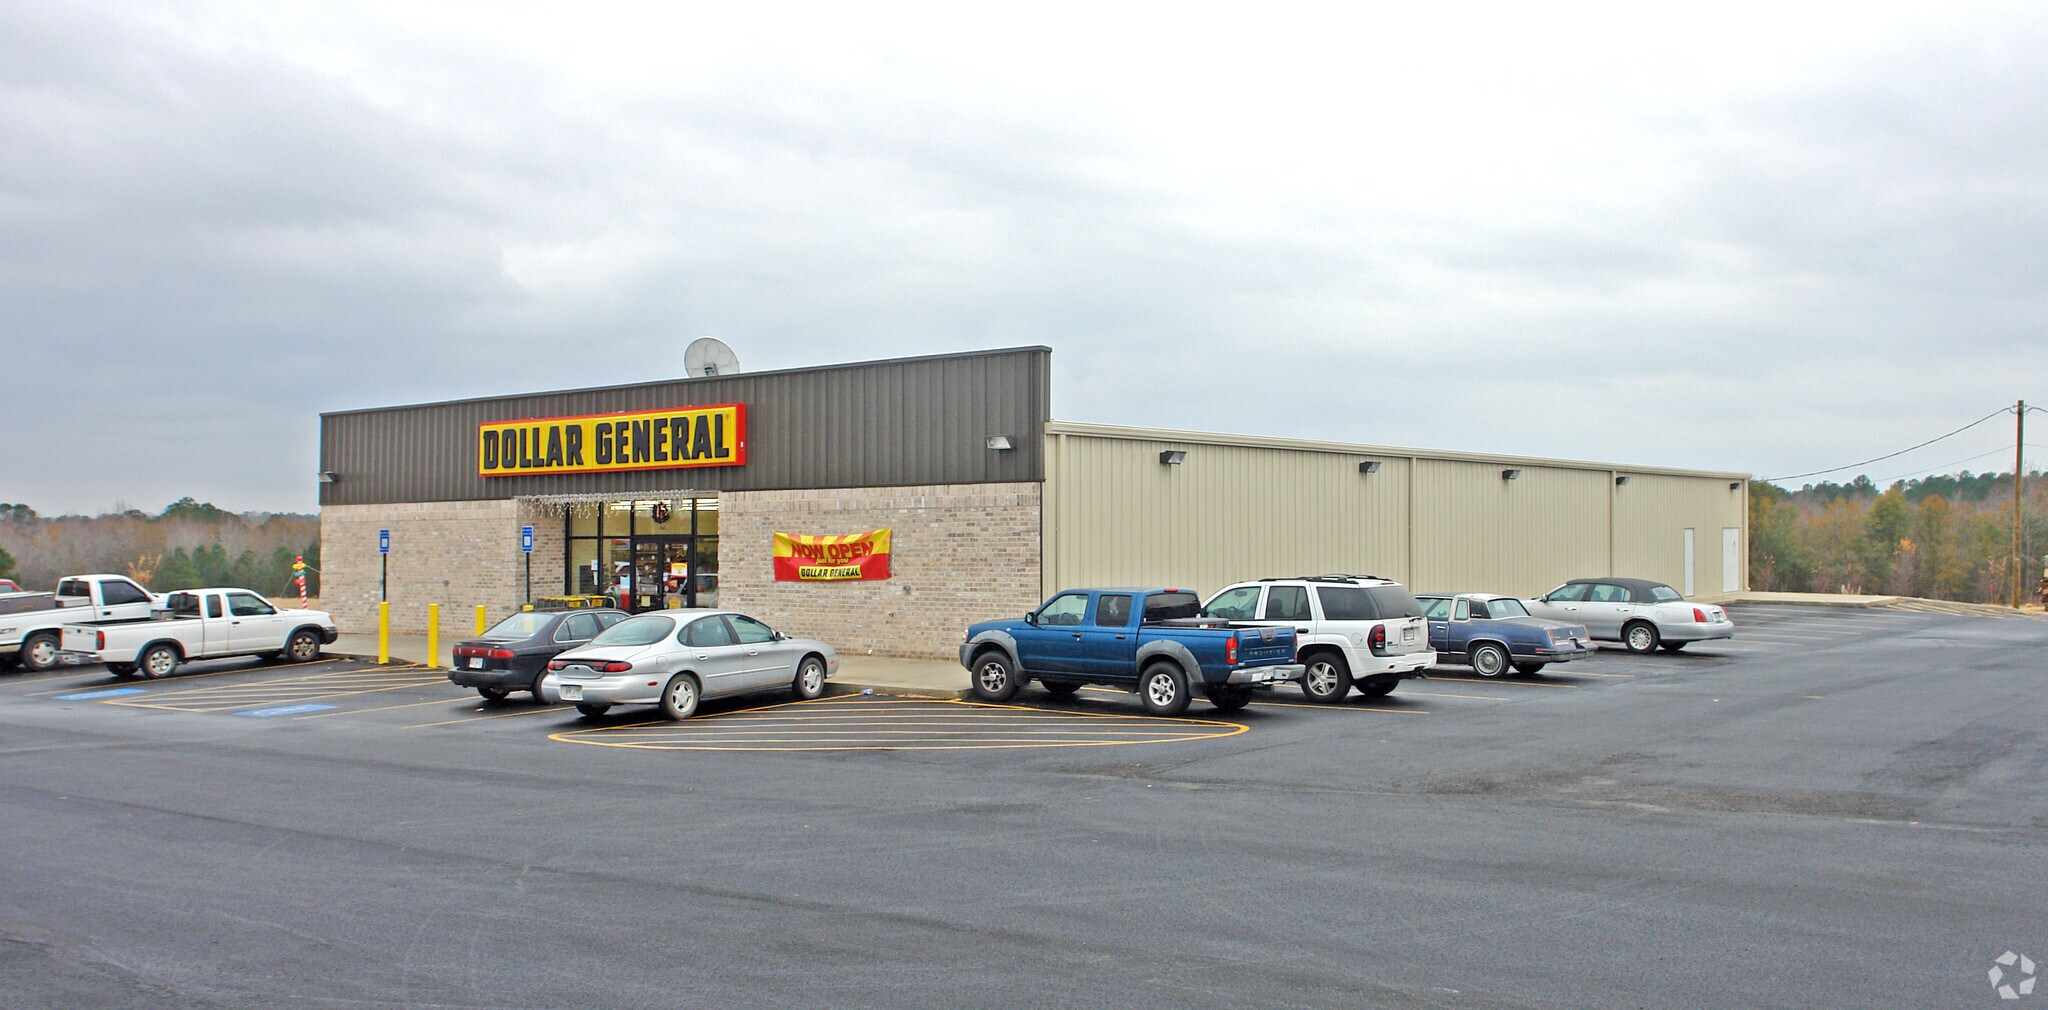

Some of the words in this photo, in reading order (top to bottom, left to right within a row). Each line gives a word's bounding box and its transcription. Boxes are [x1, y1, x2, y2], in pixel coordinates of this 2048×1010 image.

[483, 424, 584, 470] DOLLAR
[595, 413, 729, 465] GENERAL
[791, 543, 825, 559] NOW
[828, 541, 874, 559] OPEN
[801, 568, 828, 577] DOLLAR
[829, 567, 860, 577] GENERAL
